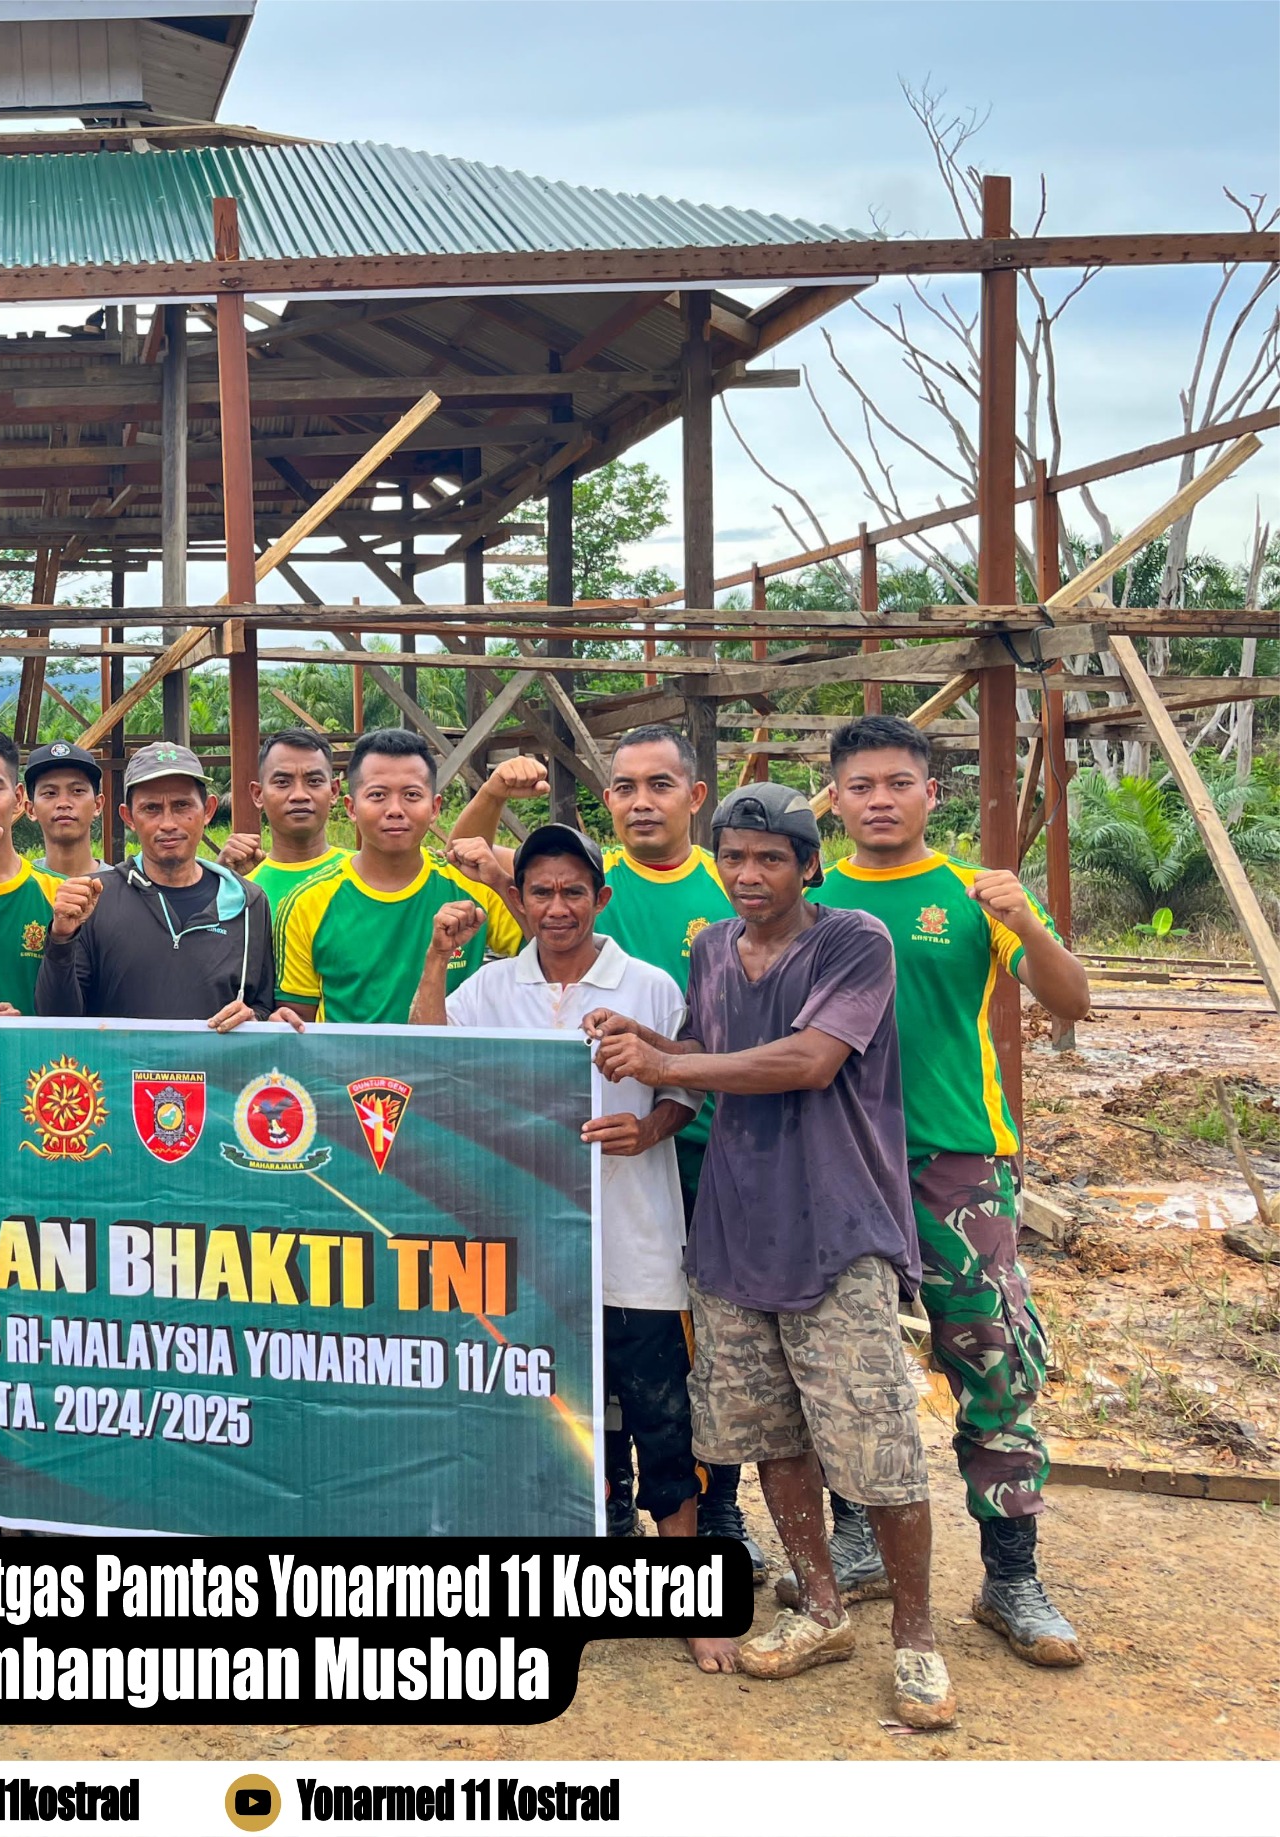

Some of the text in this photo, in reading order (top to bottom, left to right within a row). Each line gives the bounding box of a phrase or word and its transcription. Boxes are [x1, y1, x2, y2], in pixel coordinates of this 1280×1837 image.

[911, 934, 951, 944] KOSTRAD
[135, 1072, 204, 1082] MULAWARMAN
[352, 1080, 408, 1094] GUNTUR GENI
[249, 1160, 305, 1170] MAHARAJALILA
[108, 1221, 369, 1309] BHAKTI
[387, 1234, 513, 1317] TNI
[7, 1315, 236, 1376] RI-MALAYSIA
[243, 1329, 447, 1389] YONARMED
[455, 1341, 554, 1398] 11/GG
[55, 1384, 252, 1447] 2024/2025
